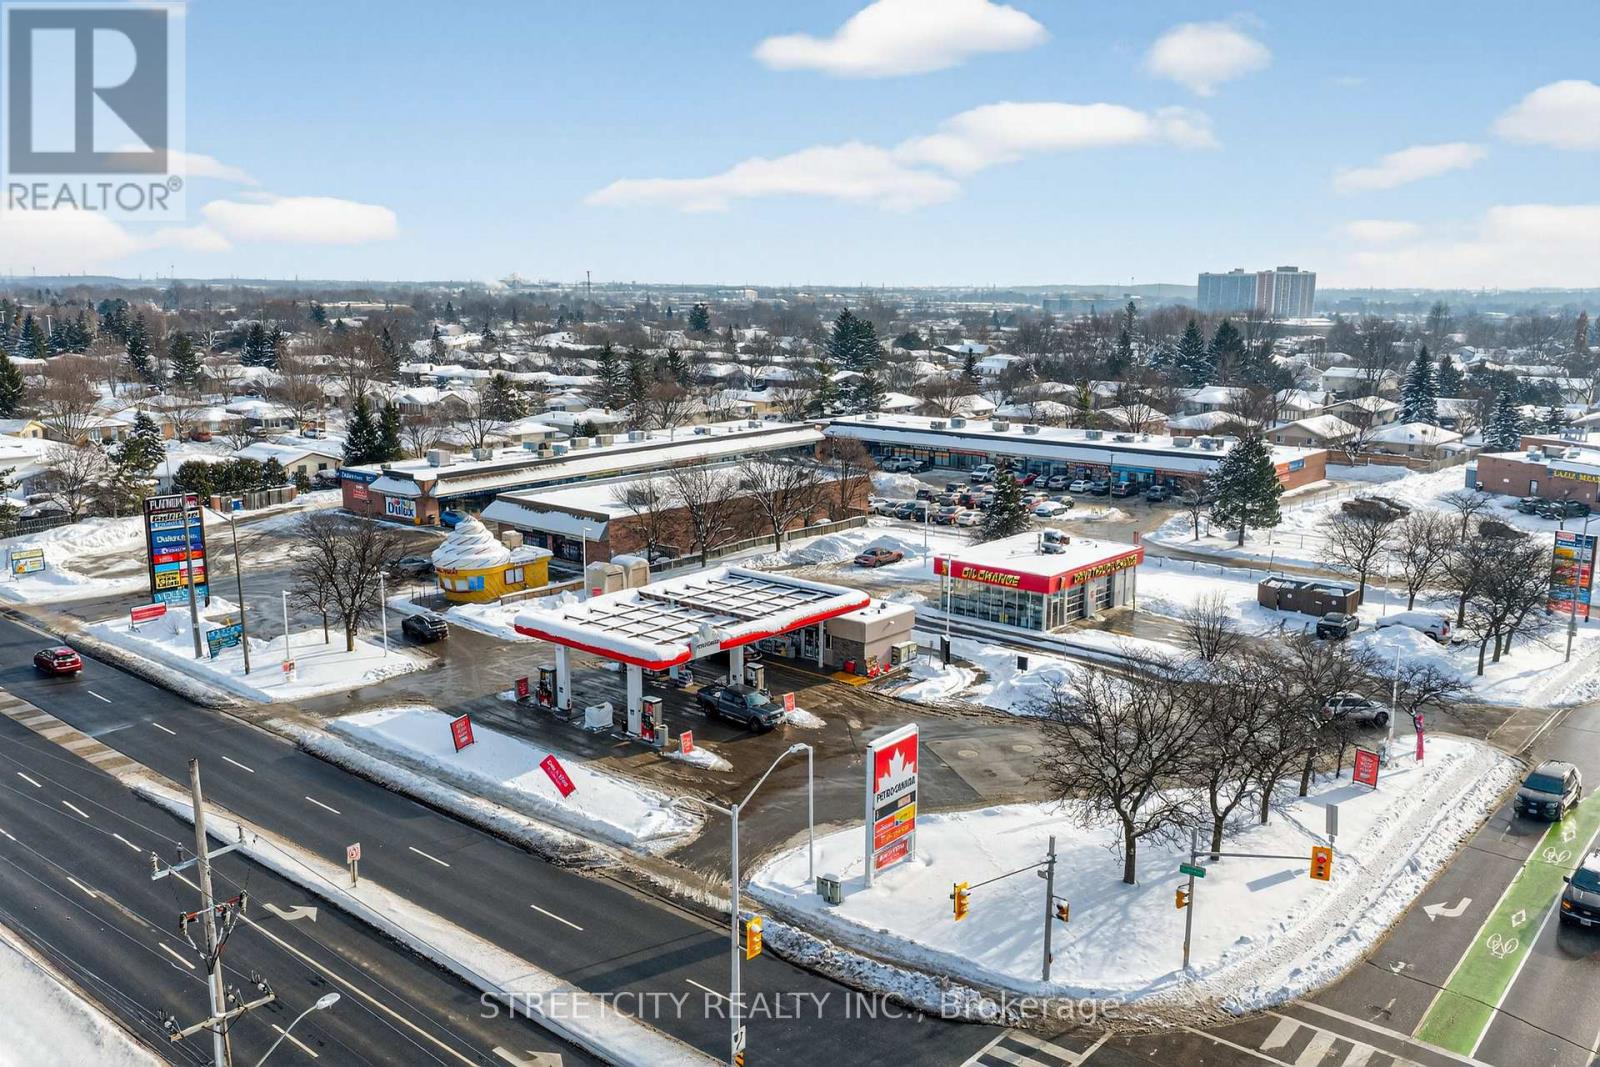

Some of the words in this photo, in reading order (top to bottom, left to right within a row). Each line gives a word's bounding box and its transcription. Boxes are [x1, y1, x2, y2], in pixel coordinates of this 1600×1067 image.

[388, 502, 414, 517] Dulux
[978, 569, 1020, 587] CHANGE
[877, 776, 915, 802] PETRO-CANADA
